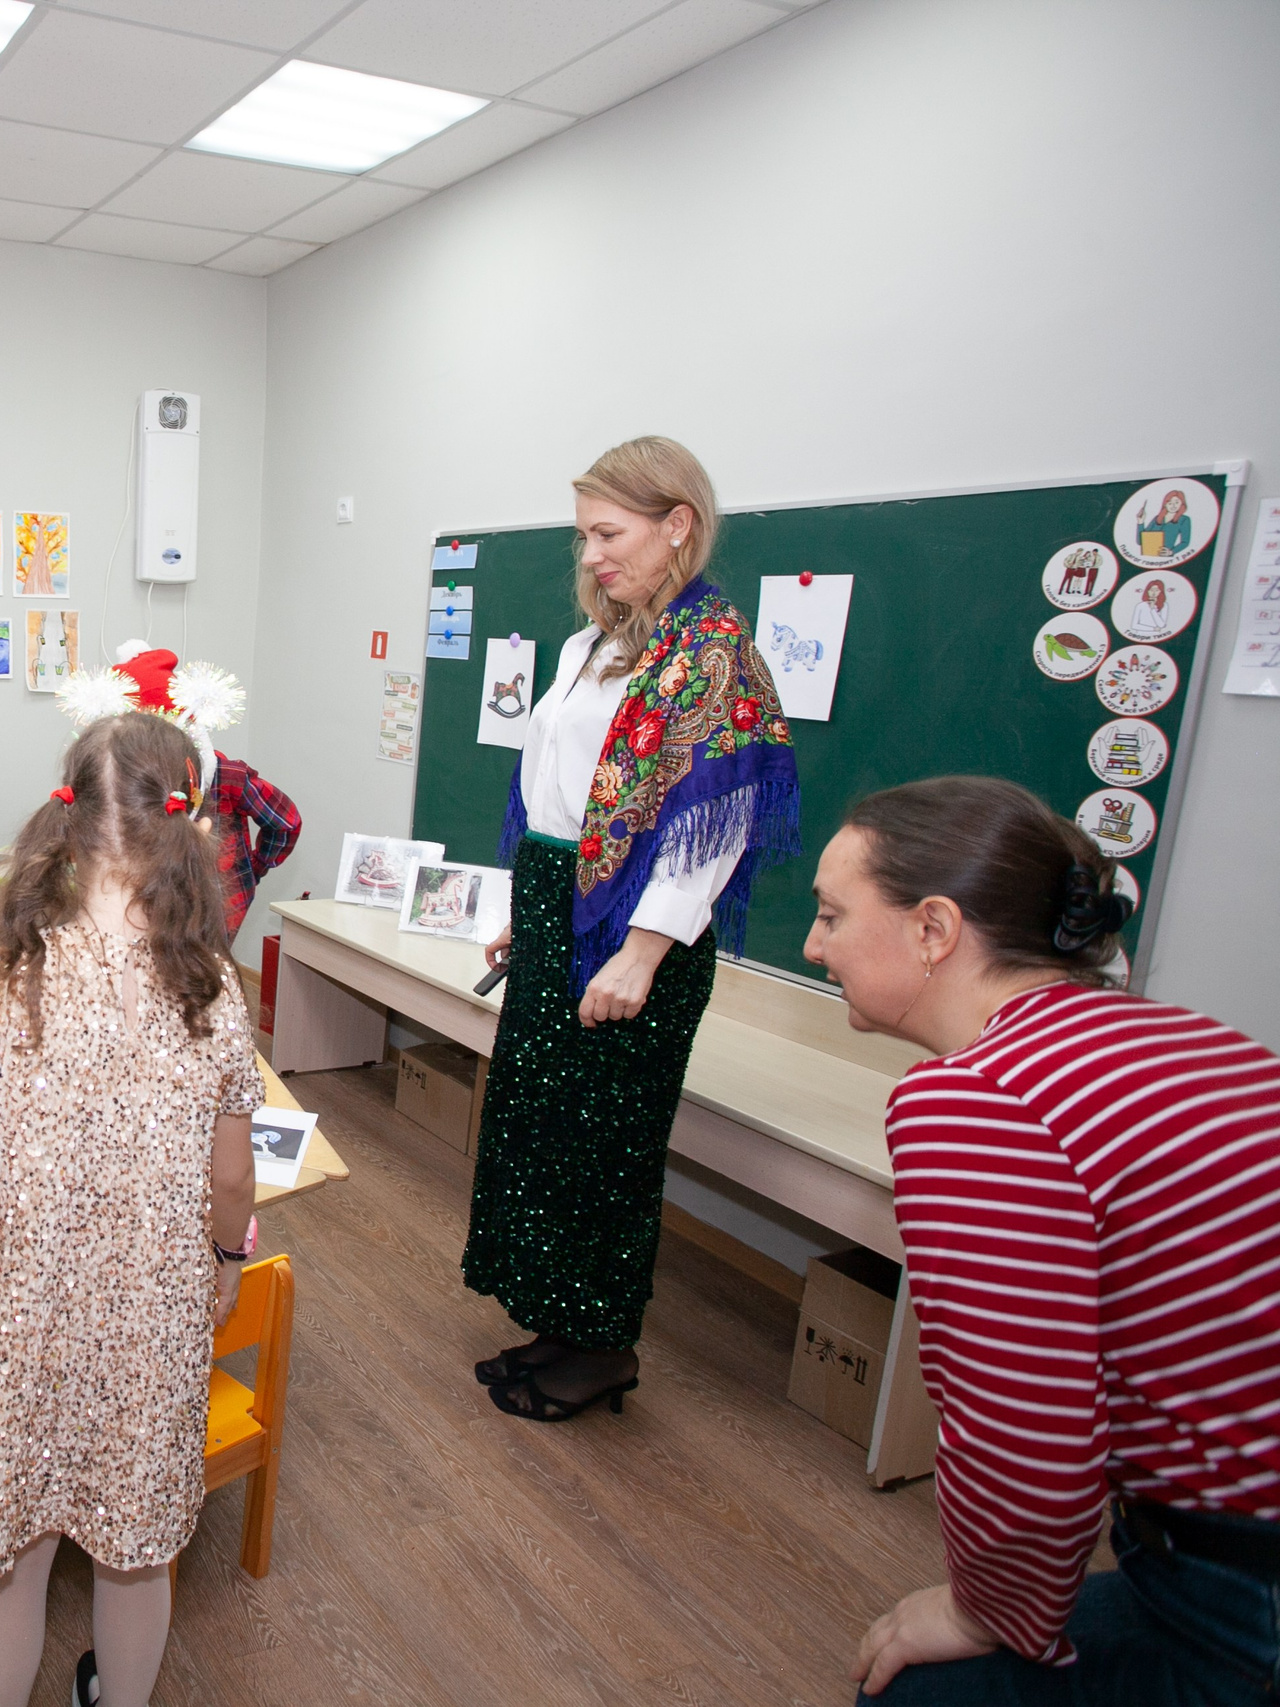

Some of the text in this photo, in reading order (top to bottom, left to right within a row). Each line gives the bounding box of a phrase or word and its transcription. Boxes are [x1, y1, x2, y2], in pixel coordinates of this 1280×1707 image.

[1119, 544, 1141, 562] Педагог
[1141, 559, 1174, 567] говорит
[1182, 549, 1196, 560] раз
[1045, 584, 1108, 608] Голова без капюшона
[437, 638, 459, 647] Февраль
[1124, 629, 1172, 640] Говори тихо
[1035, 650, 1053, 675] Скорость
[1054, 654, 1103, 678] передвижения
[1097, 679, 1105, 696] Сели
[1150, 700, 1163, 710] рук
[1089, 748, 1106, 778] Бережное
[1106, 775, 1148, 785] отношение
[1152, 753, 1165, 772] среде
[1115, 829, 1152, 855] канцелярия
